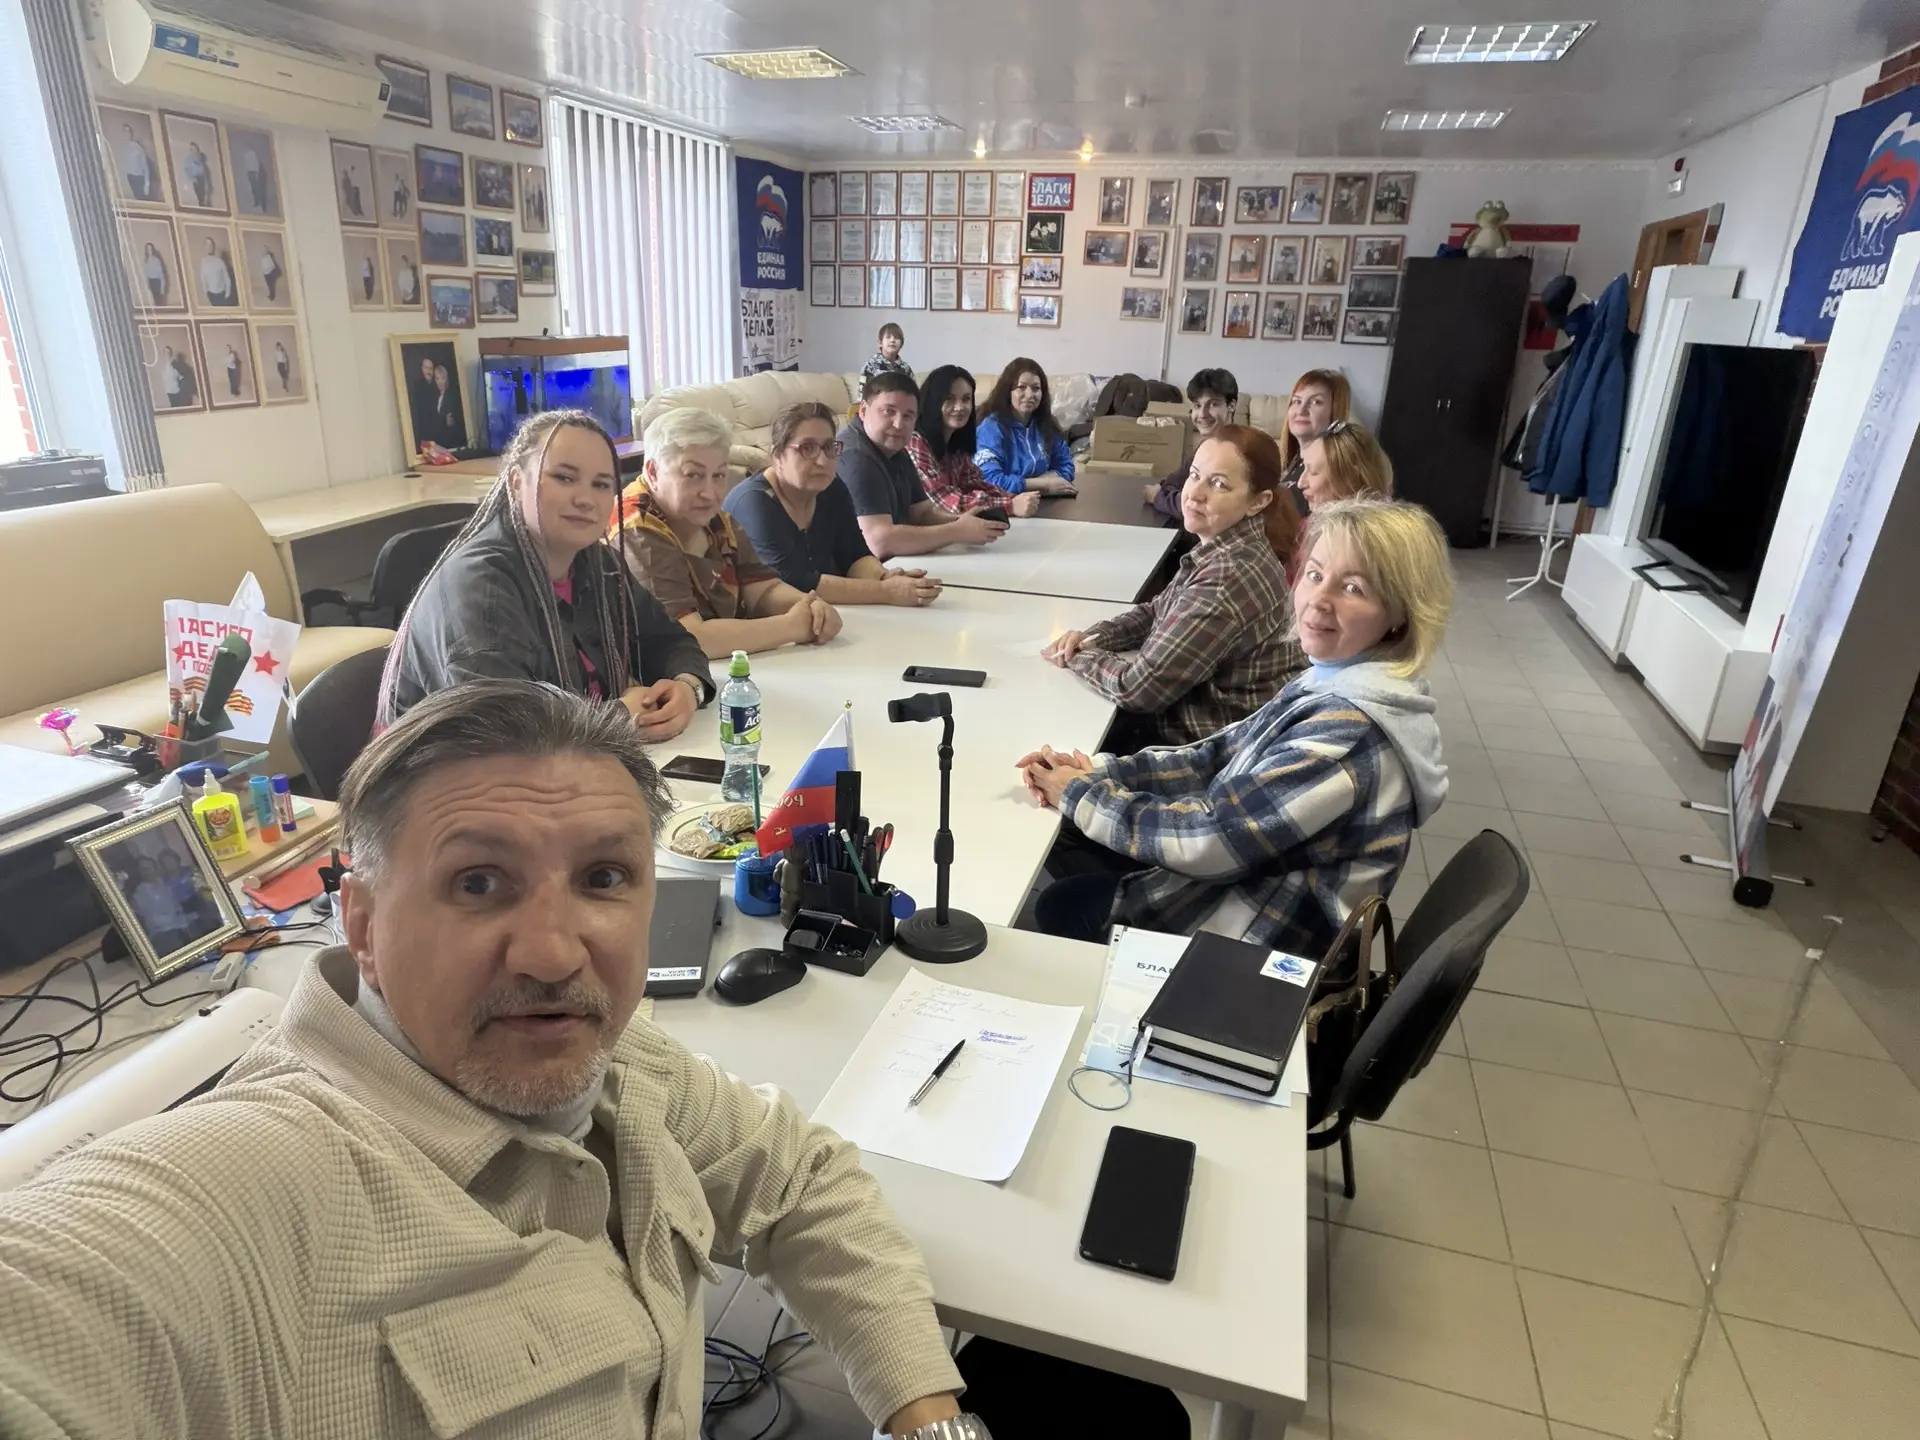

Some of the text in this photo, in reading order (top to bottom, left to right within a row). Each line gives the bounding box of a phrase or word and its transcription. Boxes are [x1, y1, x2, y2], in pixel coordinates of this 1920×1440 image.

[757, 251, 785, 266] ЕДИНАЯ
[757, 266, 785, 280] РОССИЯ
[1829, 263, 1886, 291] ЕДИНАЯ
[741, 299, 774, 318] БЛАГИЕ
